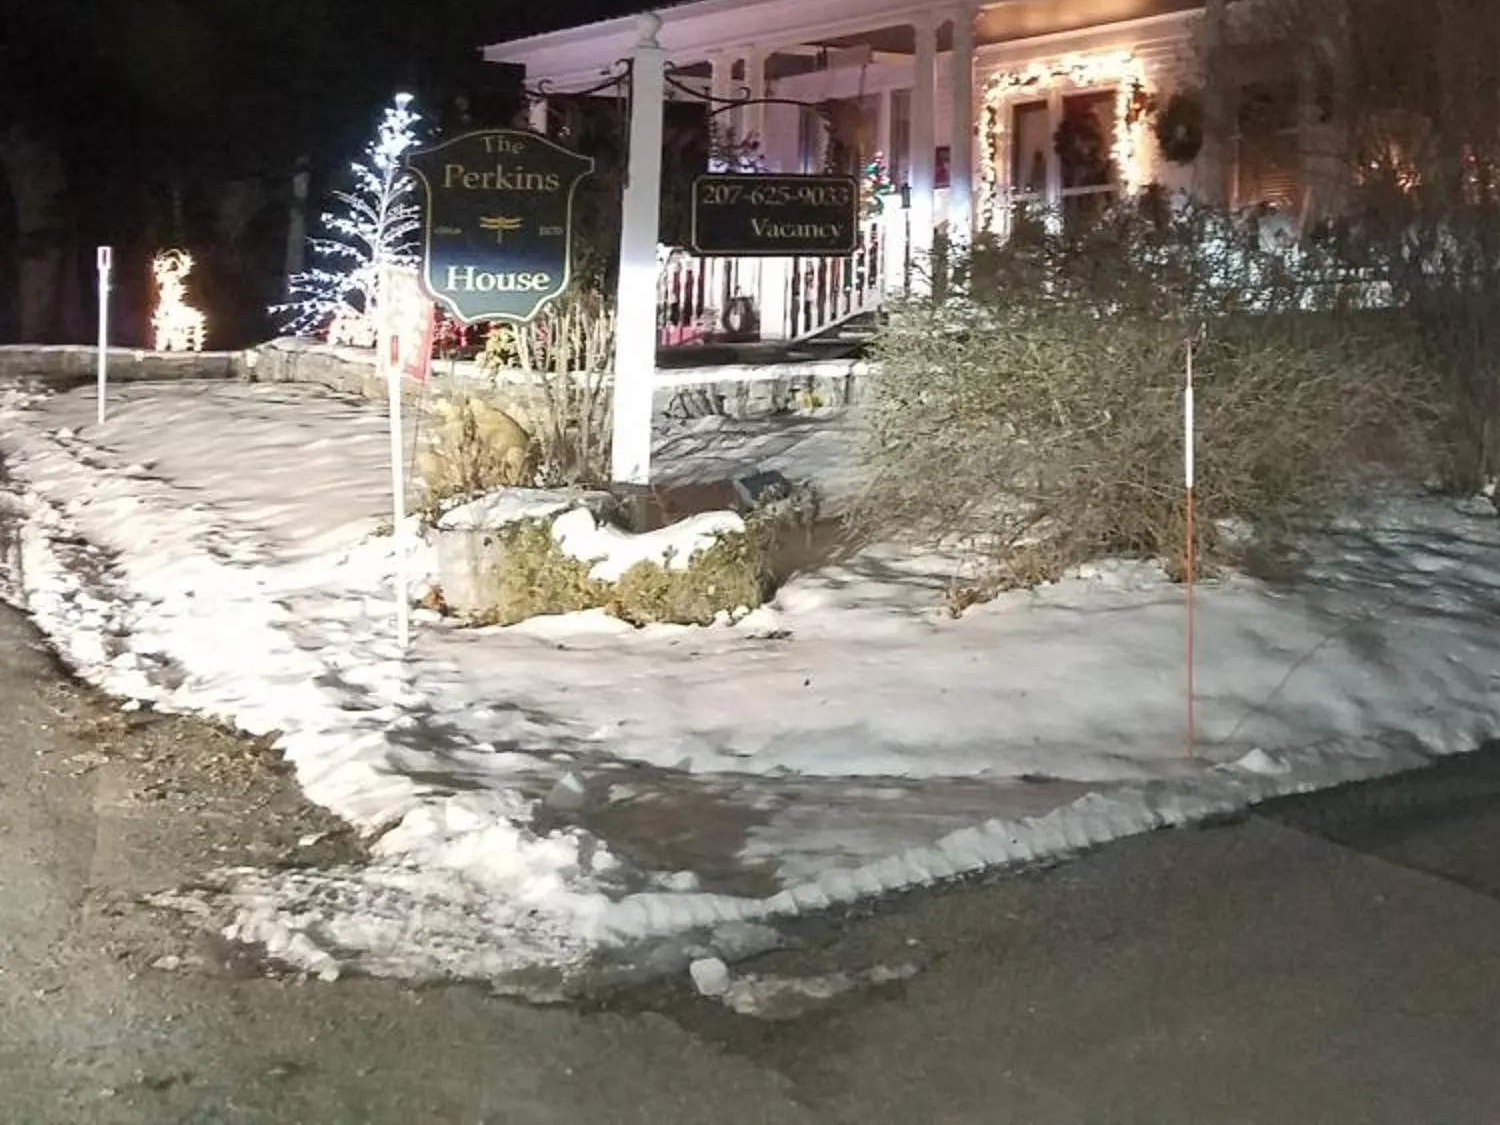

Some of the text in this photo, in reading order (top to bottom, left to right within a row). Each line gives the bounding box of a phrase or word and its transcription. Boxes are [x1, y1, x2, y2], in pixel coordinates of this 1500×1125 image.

[480, 136, 525, 154] The
[443, 163, 561, 192] Perkins
[751, 217, 845, 244] Vacancy
[446, 265, 551, 292] House
